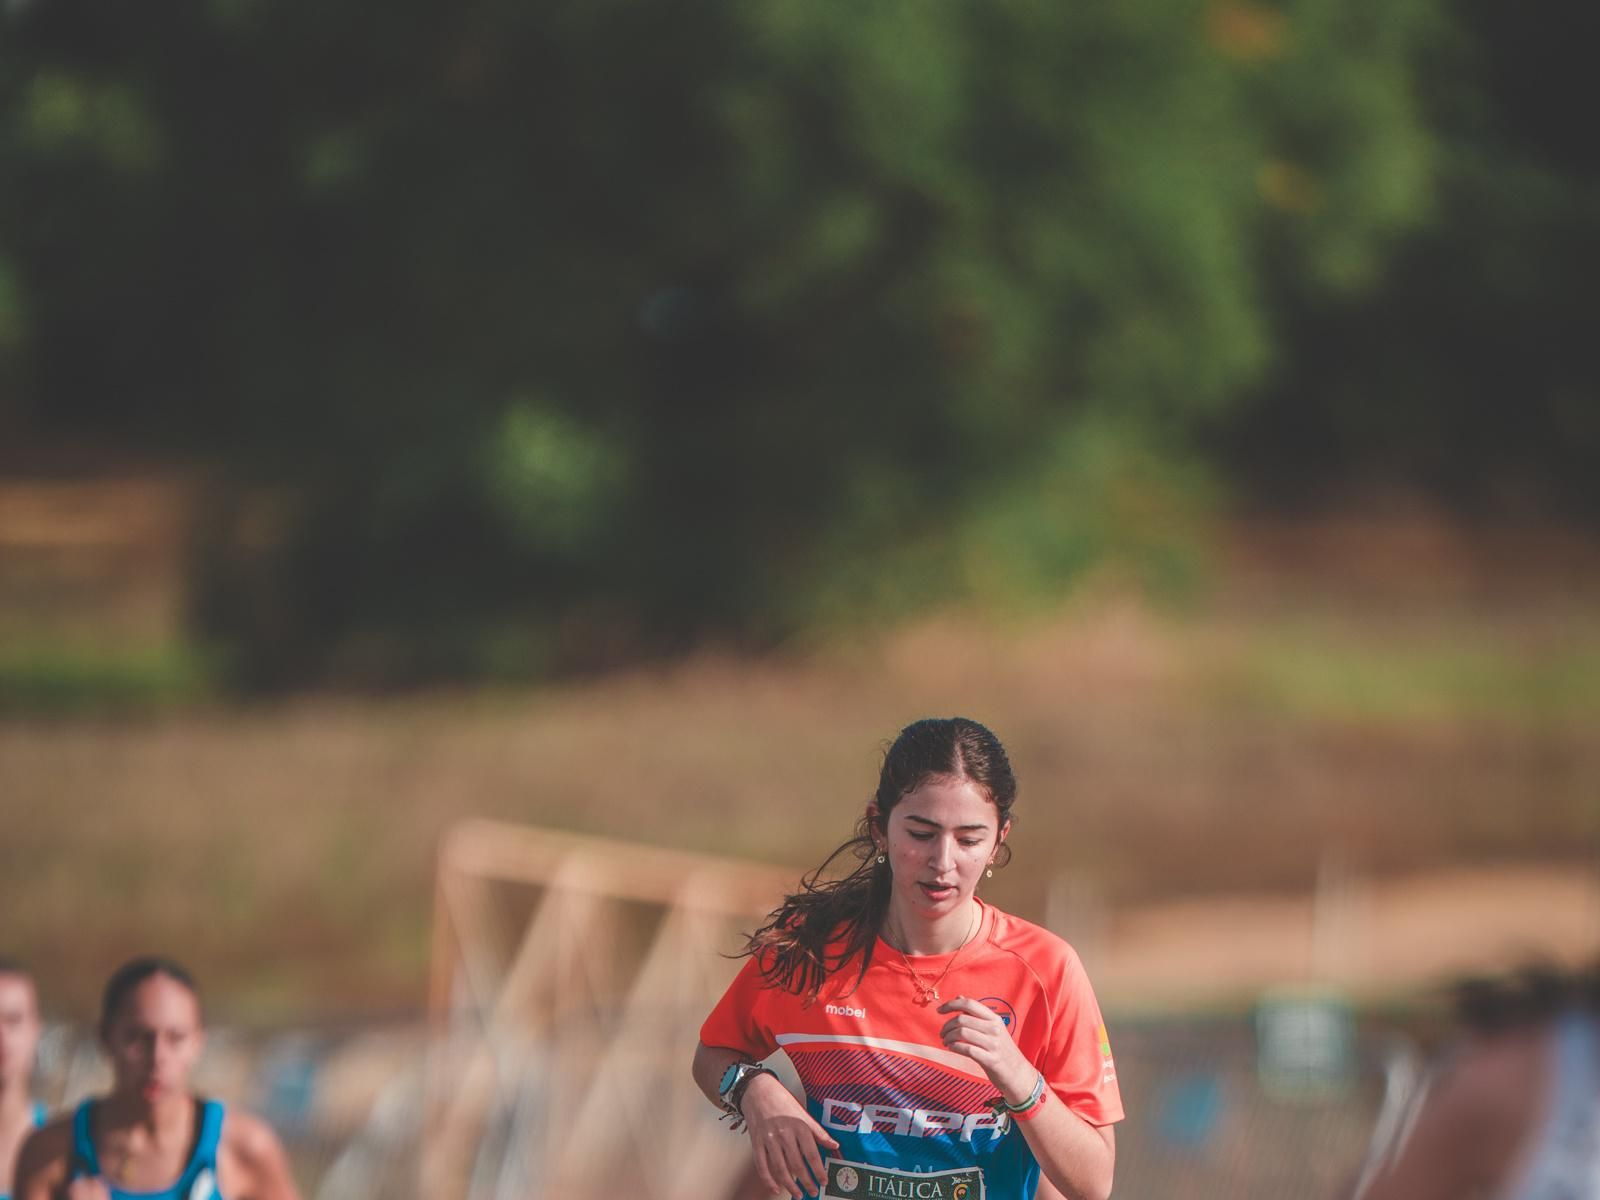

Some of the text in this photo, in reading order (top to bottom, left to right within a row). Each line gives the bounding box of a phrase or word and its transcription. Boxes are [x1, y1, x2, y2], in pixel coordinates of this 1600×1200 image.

[825, 1004, 866, 1019] mobel
[821, 1098, 1009, 1142] CAPA
[868, 1175, 943, 1199] ITÁLICA
